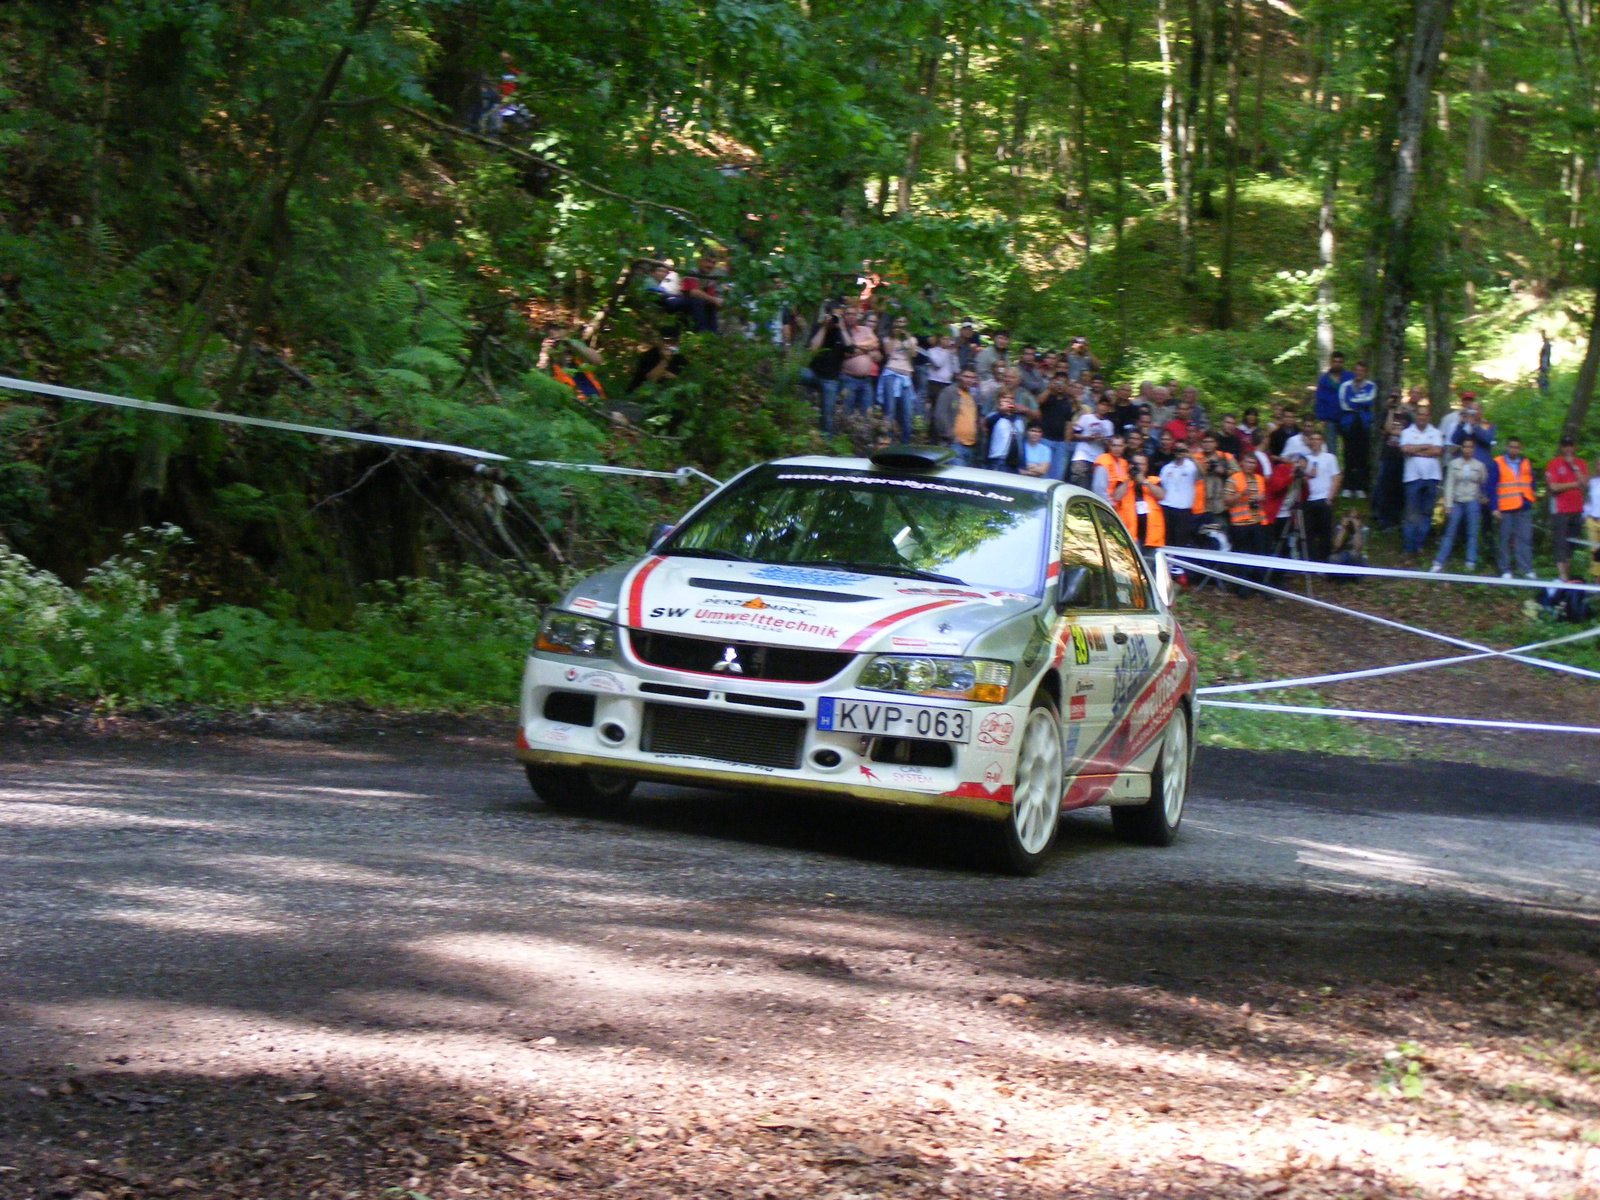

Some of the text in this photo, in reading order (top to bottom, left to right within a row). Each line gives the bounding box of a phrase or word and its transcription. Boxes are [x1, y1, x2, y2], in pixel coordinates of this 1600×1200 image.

[649, 607, 840, 638] SW Umwelttechnik
[820, 716, 831, 726] H
[839, 702, 965, 739] KVP-063
